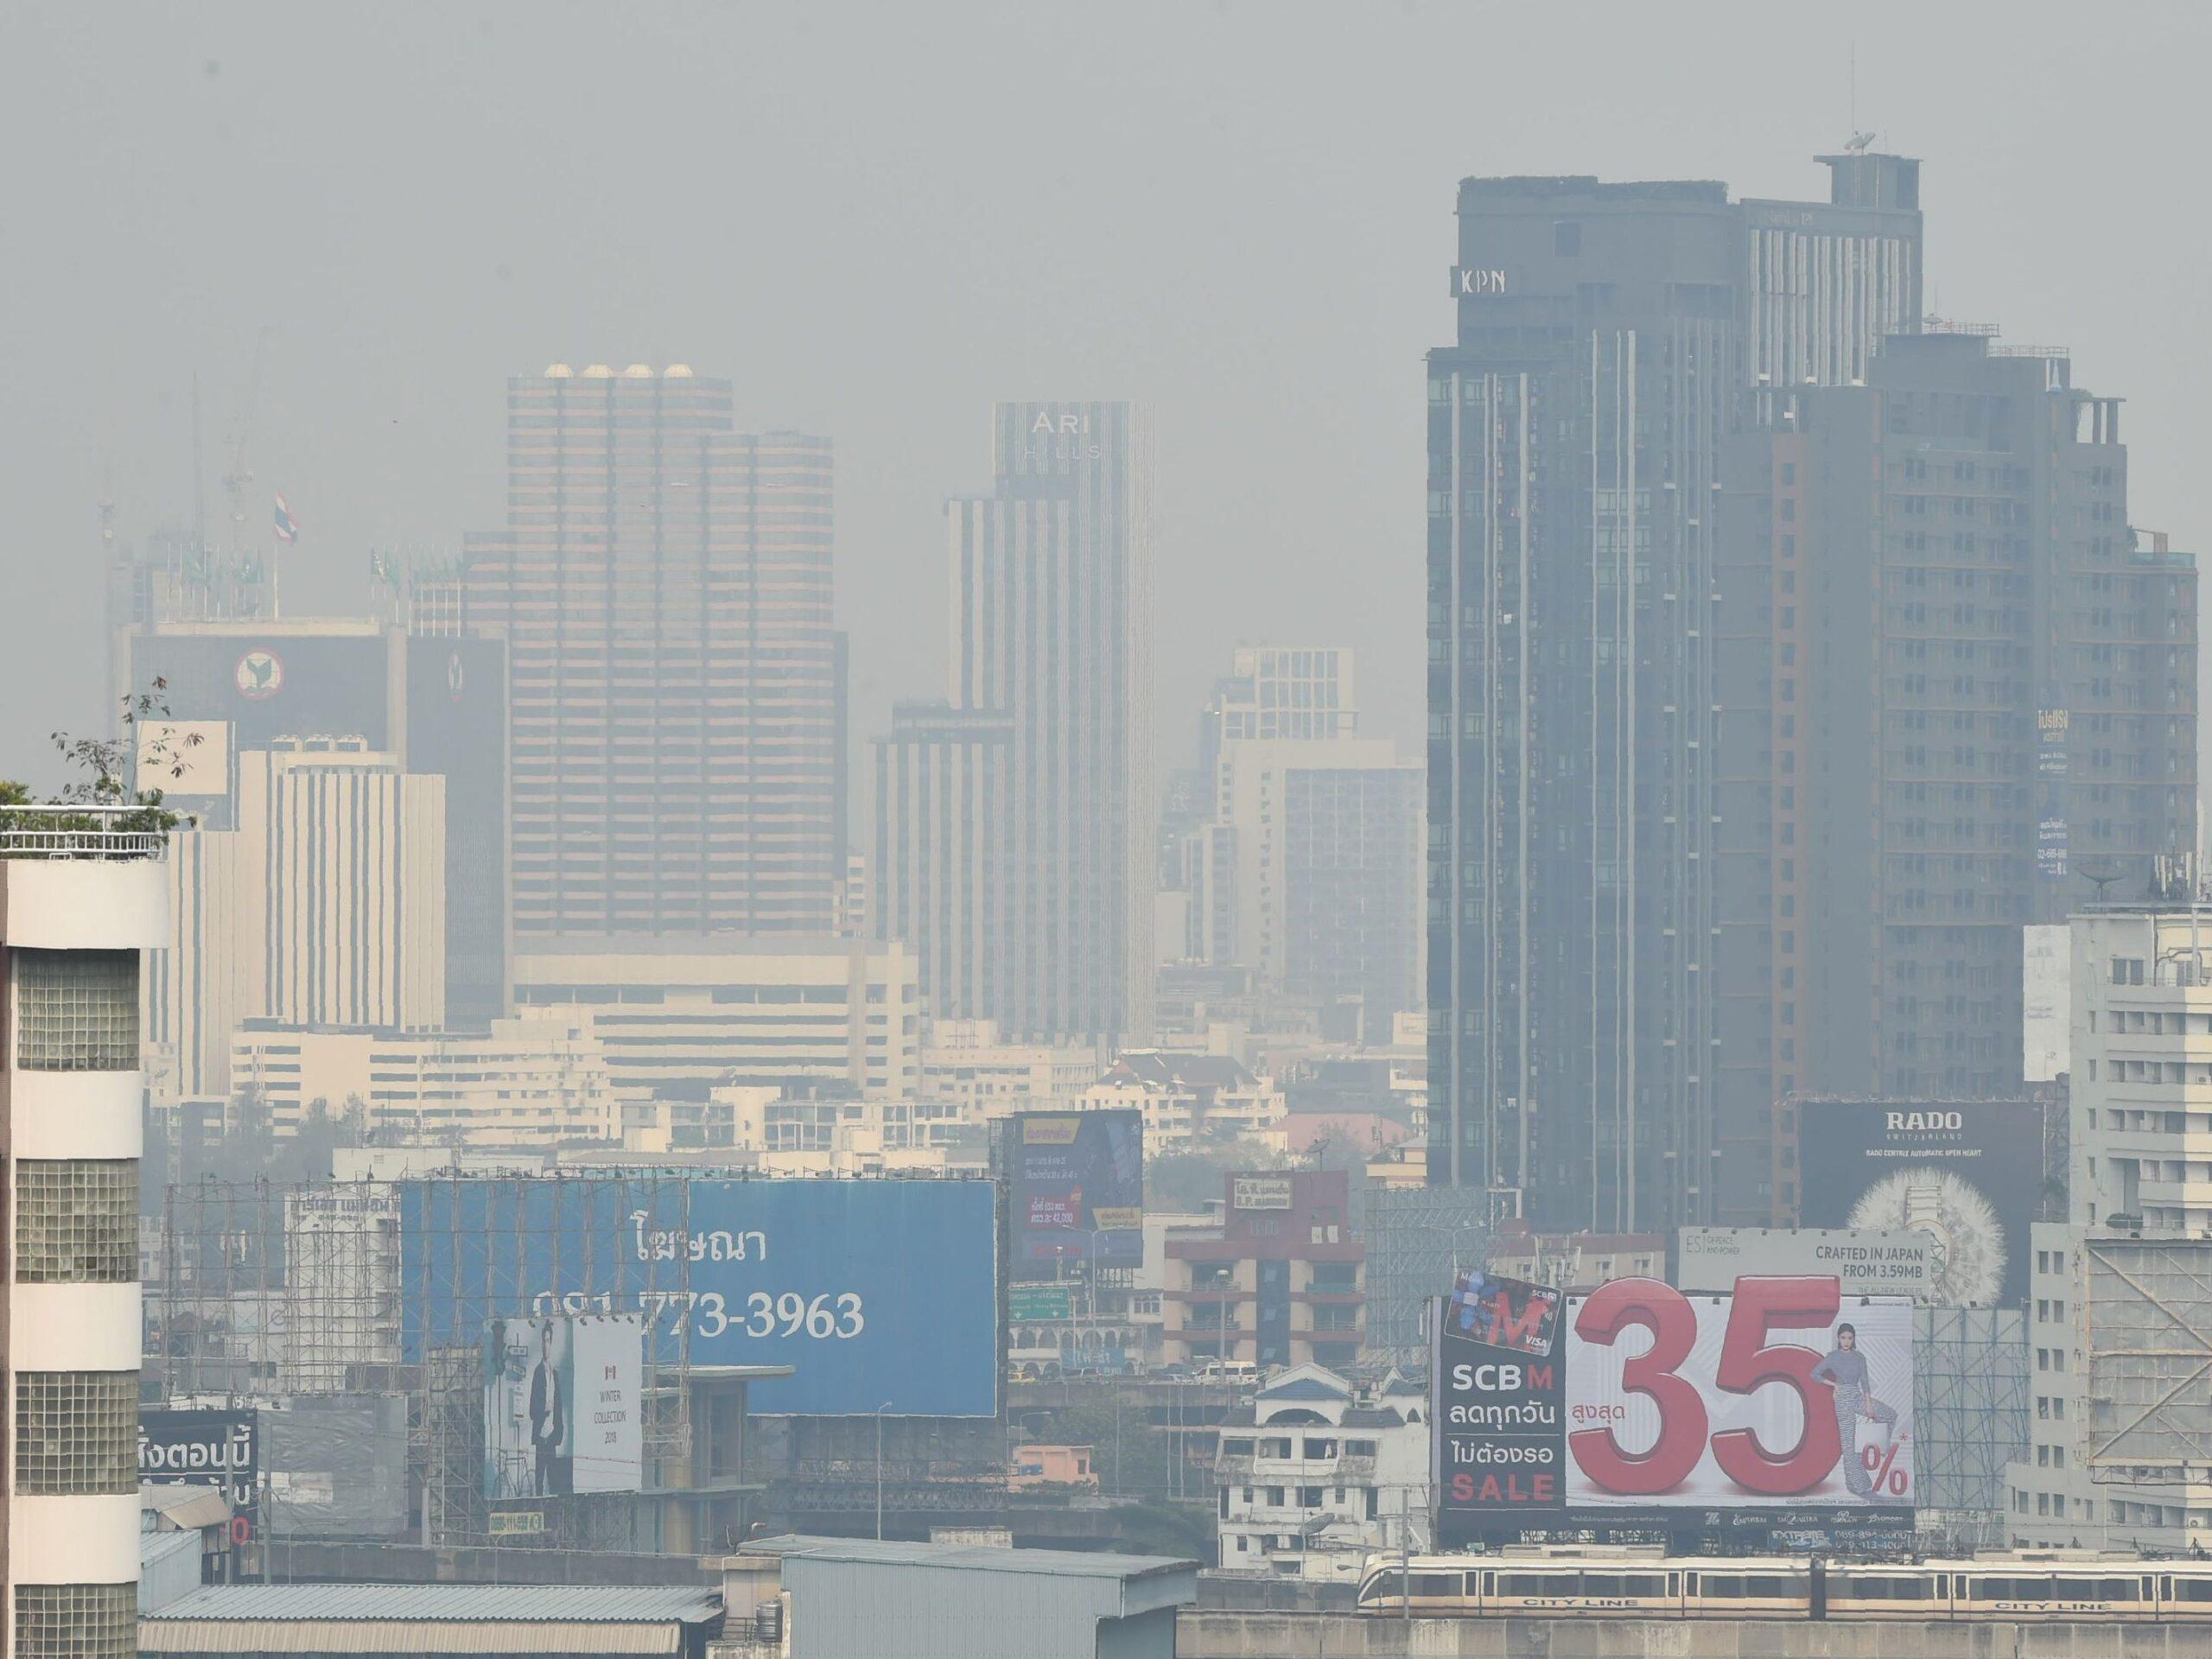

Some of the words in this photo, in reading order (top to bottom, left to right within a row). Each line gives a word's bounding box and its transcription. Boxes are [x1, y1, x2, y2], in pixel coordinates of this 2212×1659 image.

[1461, 270, 1505, 293] KPN
[1031, 411, 1090, 434] ARI
[1024, 445, 1100, 460] HILLS
[1885, 1111, 1962, 1130] RADO
[1910, 1149, 1944, 1158] AUTOMATIC
[629, 1210, 766, 1262] โฆษณา
[1815, 1246, 1867, 1260] CRAFTED
[1870, 1247, 1883, 1261] IN
[1885, 1248, 1923, 1262] JAPAN
[1843, 1264, 1877, 1278] FROM
[1879, 1265, 1923, 1279] 3.59MB
[1525, 1334, 1548, 1349] VISA
[1452, 1363, 1522, 1391] SCB
[1568, 1274, 1843, 1497] 35
[600, 1389, 622, 1403] WINTER
[594, 1410, 626, 1425] COLLECTION
[1449, 1400, 1555, 1431] ลดทุกวัน
[1572, 1404, 1625, 1424] สูงสุด
[604, 1431, 617, 1445] 2018
[1451, 1440, 1554, 1464] ไม่ต้องรอ
[1452, 1473, 1555, 1502] SALE
